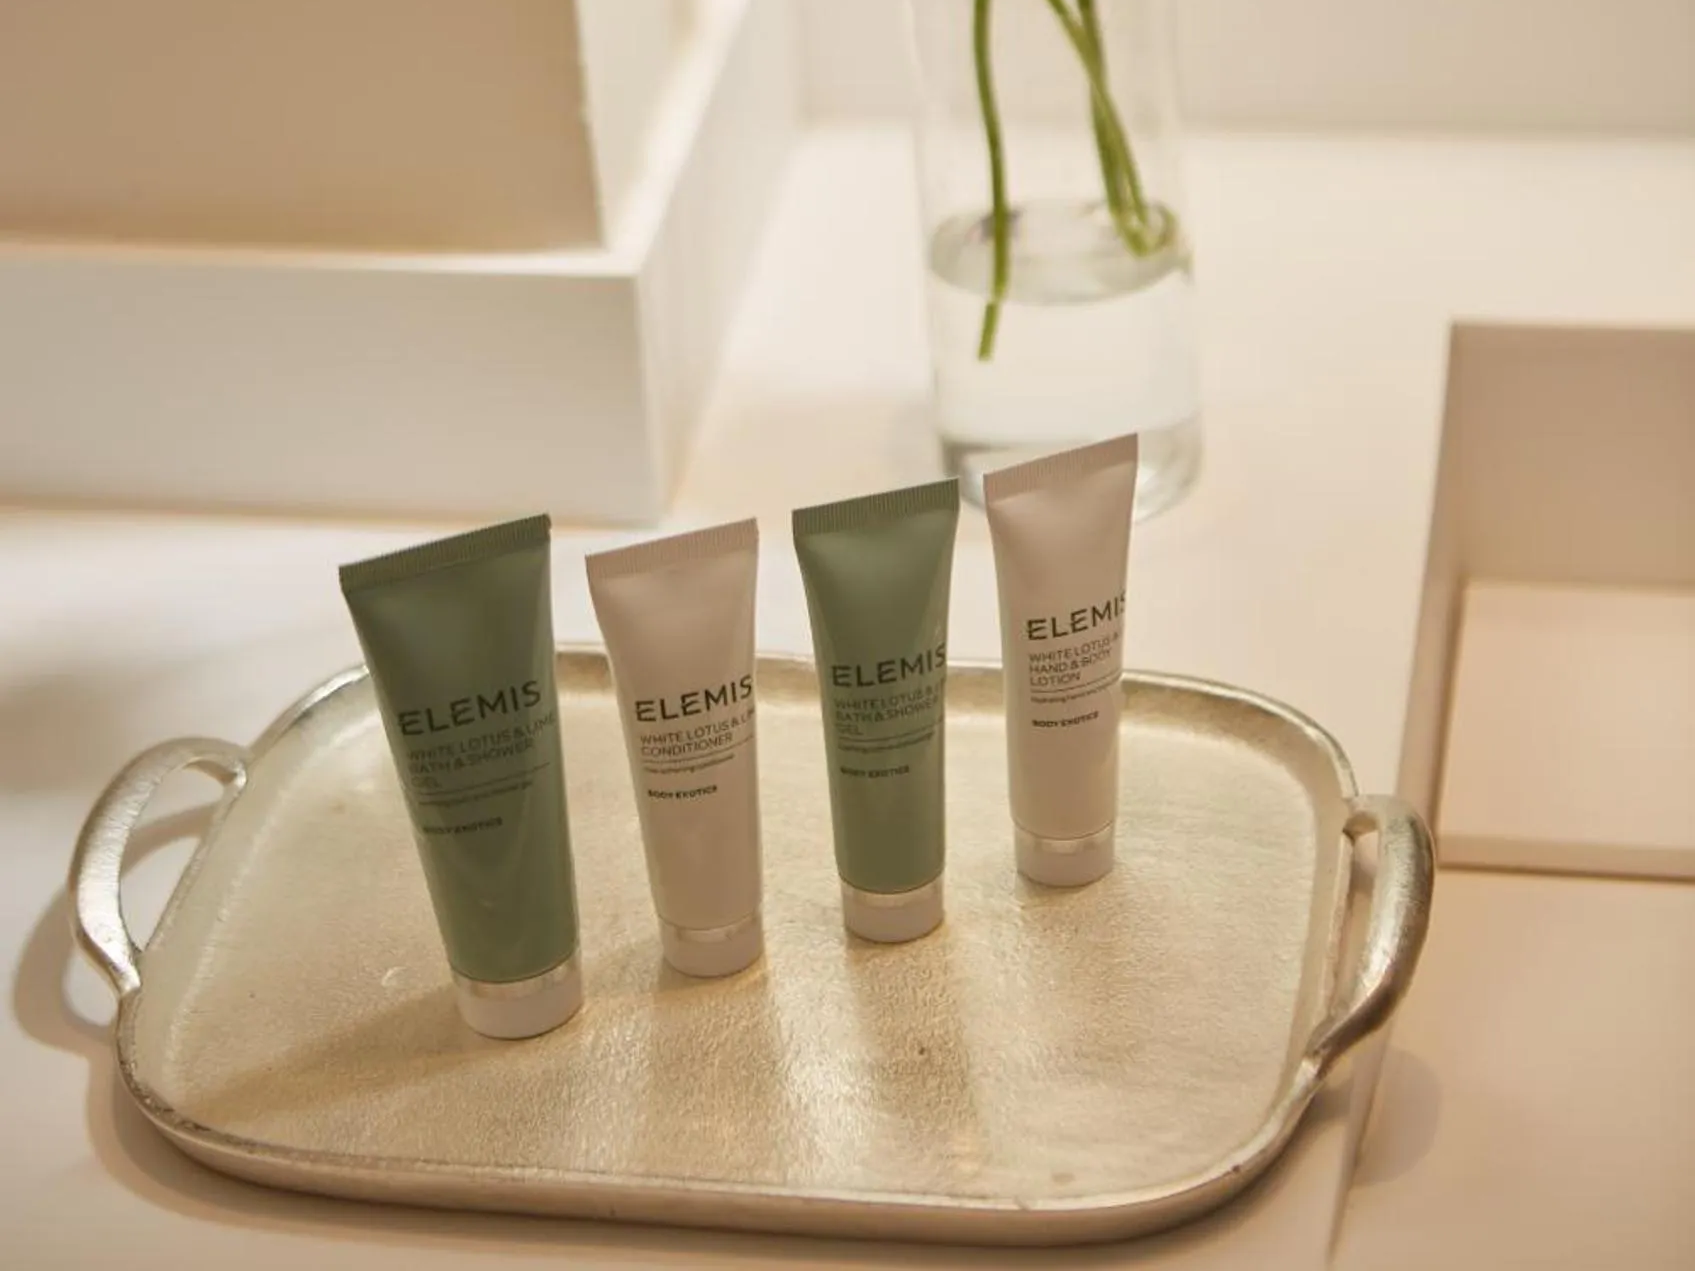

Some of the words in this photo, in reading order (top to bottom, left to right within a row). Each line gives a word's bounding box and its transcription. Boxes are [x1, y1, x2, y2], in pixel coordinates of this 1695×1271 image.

[831, 641, 946, 688] ELEMIS
[1029, 648, 1073, 663] WHITE
[1030, 662, 1069, 675] HAND
[1031, 671, 1081, 687] LOTION
[398, 680, 542, 737] ELEMIS
[635, 674, 753, 722] ELEMIS
[641, 731, 683, 744] WHITE
[686, 720, 729, 741] LOTUS
[642, 732, 733, 758] CONDITIONER
[407, 744, 455, 762] WHITE
[459, 729, 512, 754] LOTUS
